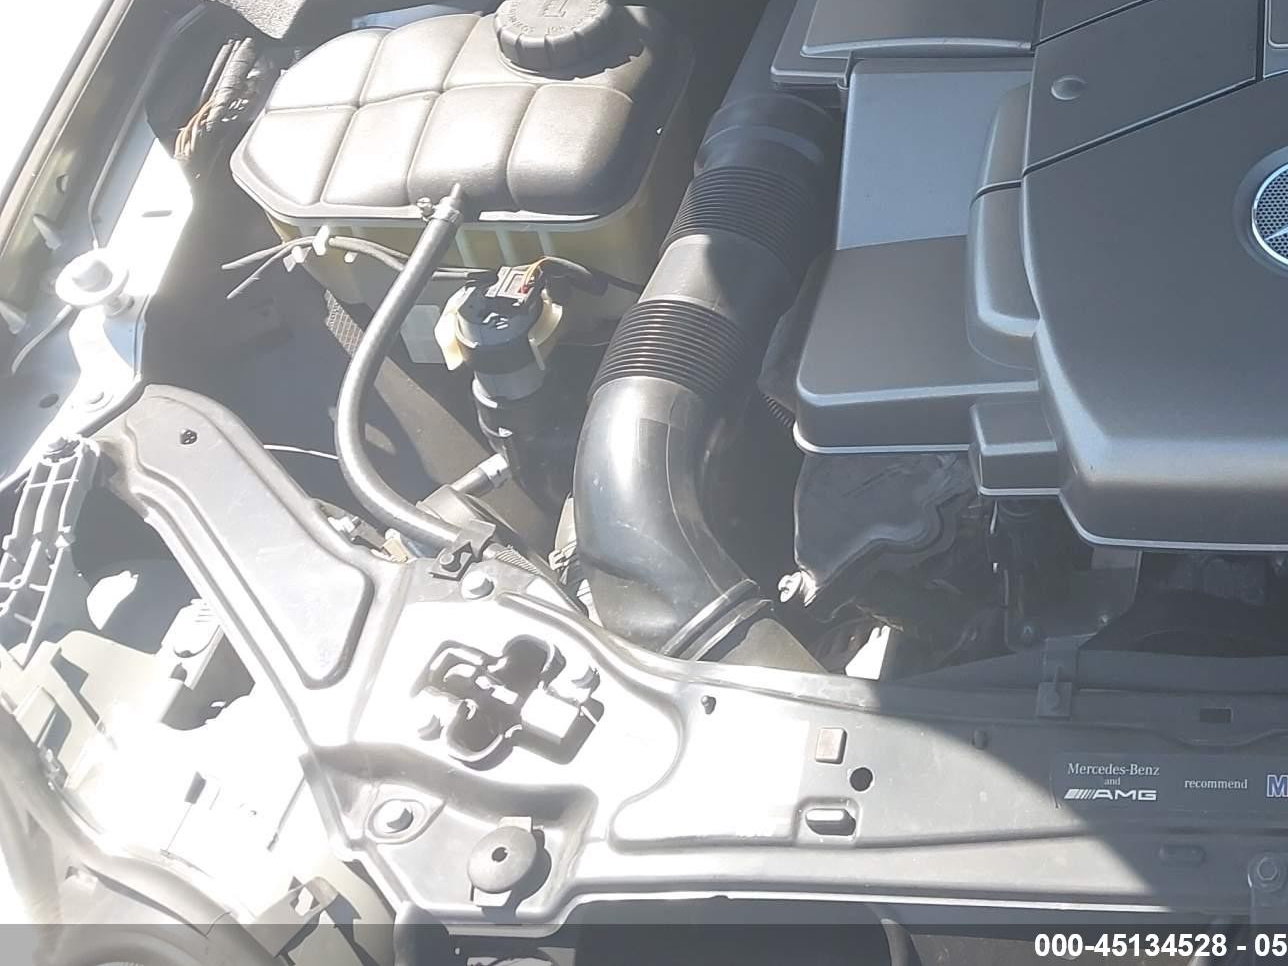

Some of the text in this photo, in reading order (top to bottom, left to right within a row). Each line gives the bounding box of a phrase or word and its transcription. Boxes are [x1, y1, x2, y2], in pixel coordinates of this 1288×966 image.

[1066, 762, 1160, 776] Mercedes-Benz
[1103, 777, 1122, 786] and
[1184, 778, 1248, 789] recommend
[1093, 789, 1158, 801] AMG
